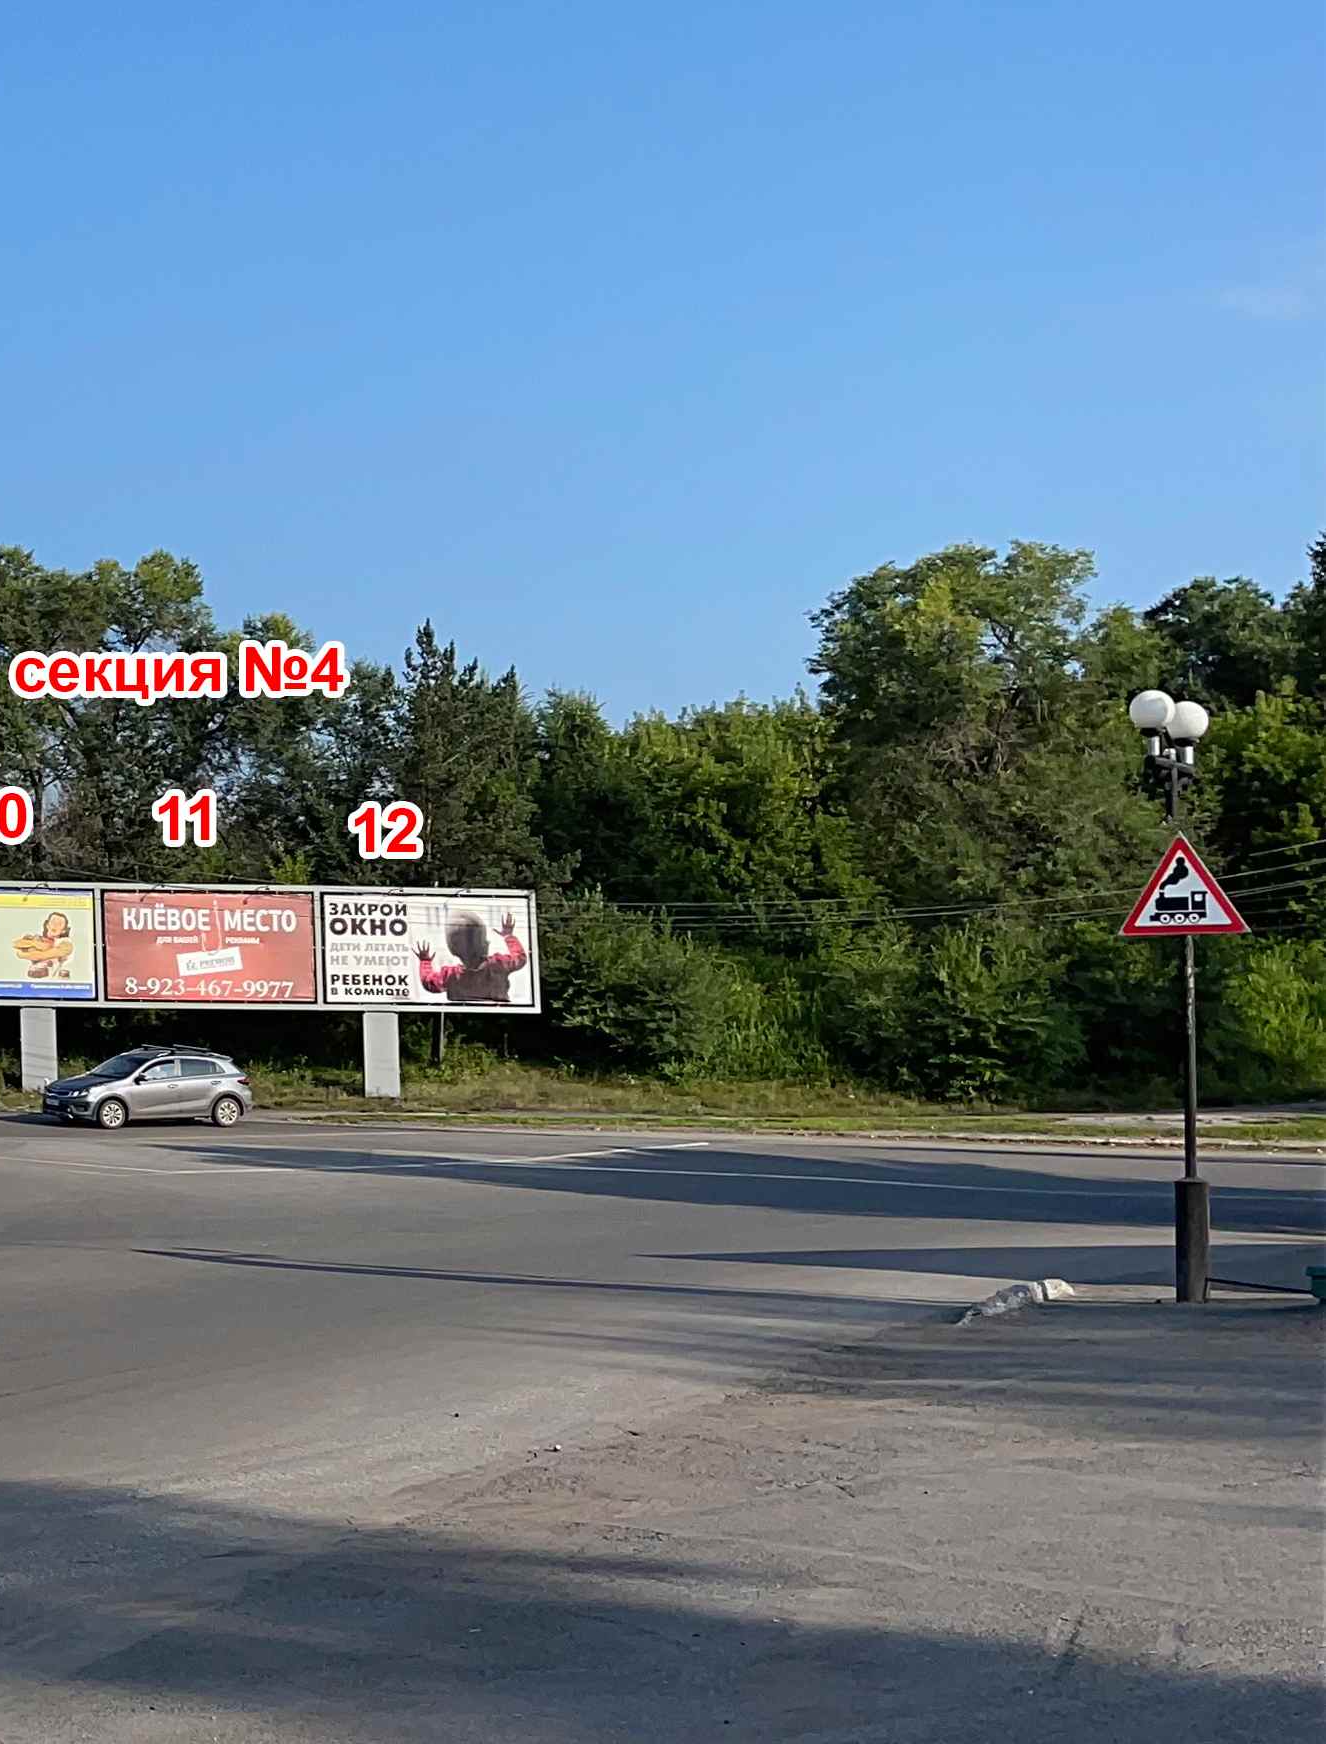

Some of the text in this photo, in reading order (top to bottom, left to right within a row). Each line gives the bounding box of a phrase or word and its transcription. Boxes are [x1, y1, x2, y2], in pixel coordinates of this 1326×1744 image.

[329, 901, 408, 917] ЗАКРОЙ
[123, 903, 297, 932] КЛЁВОЕ МЕСТО
[329, 917, 408, 937] ОКНО
[330, 942, 409, 953] ДЕТИ ЛЕТАТЬ
[330, 955, 409, 967] НЕ УМЕЮТ
[125, 977, 294, 998] 8-923-467-9977
[331, 974, 409, 986] РЕБЕНОК
